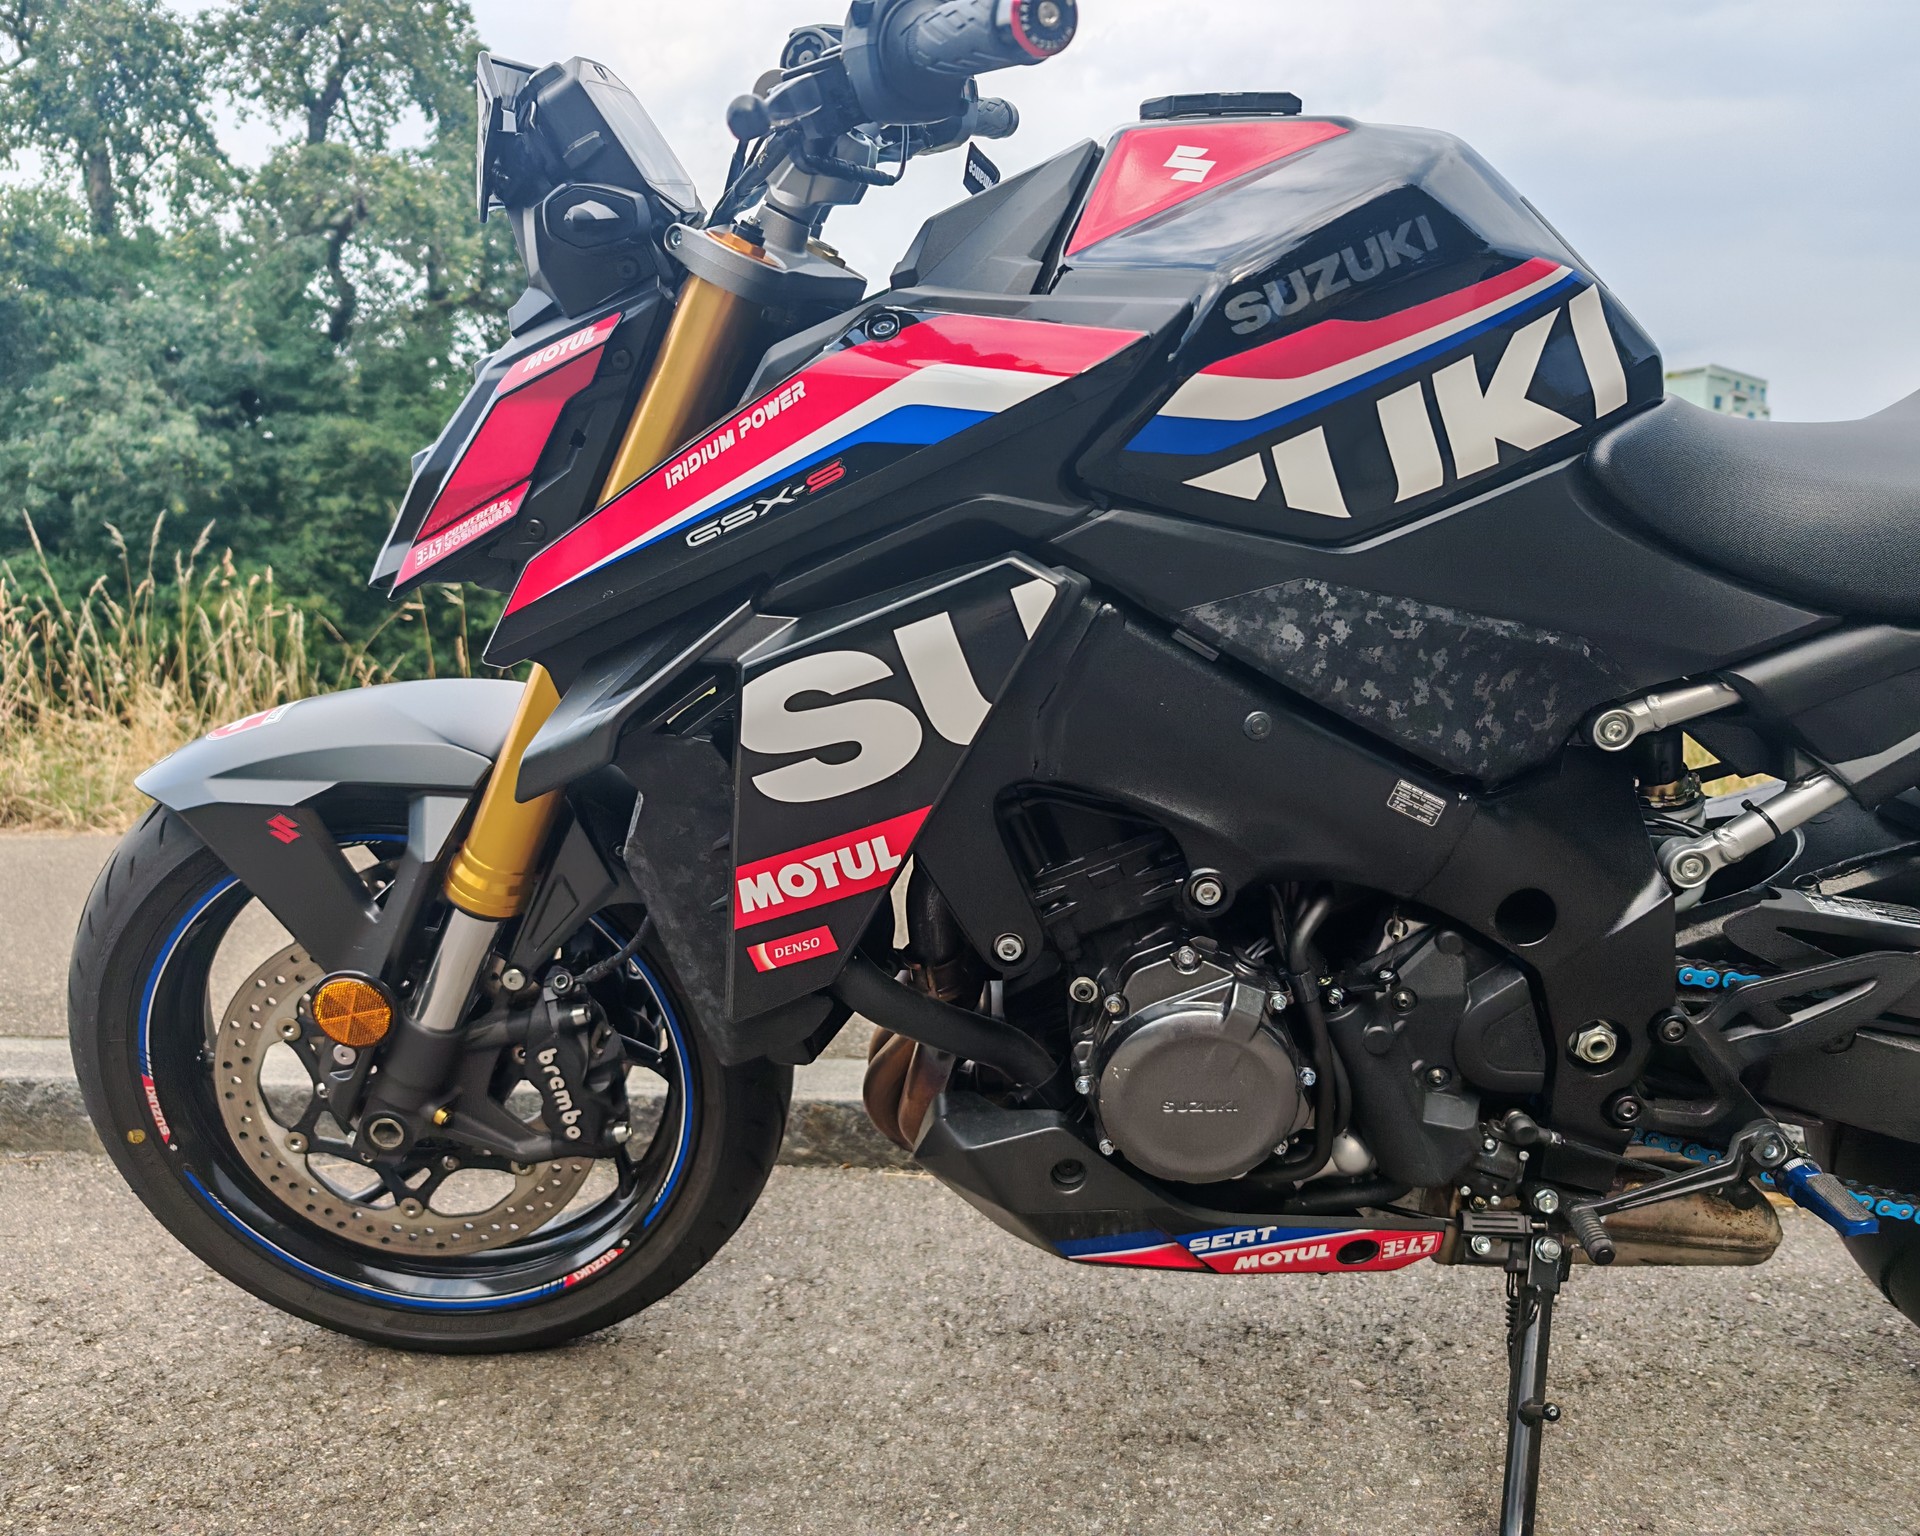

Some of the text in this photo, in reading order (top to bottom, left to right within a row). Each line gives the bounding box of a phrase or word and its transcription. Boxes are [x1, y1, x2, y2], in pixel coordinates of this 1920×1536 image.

[1224, 215, 1438, 335] SUZUKI
[523, 326, 597, 373] MOTUL
[665, 380, 806, 490] IRIDIUM POWER
[686, 458, 846, 547] GSX-S
[444, 503, 512, 551] YOSHIMURA
[737, 835, 901, 914] MOTUL
[774, 937, 820, 959] DENSO
[145, 1086, 170, 1135] SUZUKI
[538, 1048, 582, 1140] brembo
[1162, 1101, 1238, 1113] SUZUKI
[1189, 1226, 1277, 1251] SERT
[1233, 1244, 1330, 1271] MOTUL
[573, 1249, 618, 1281] SUZUKI
